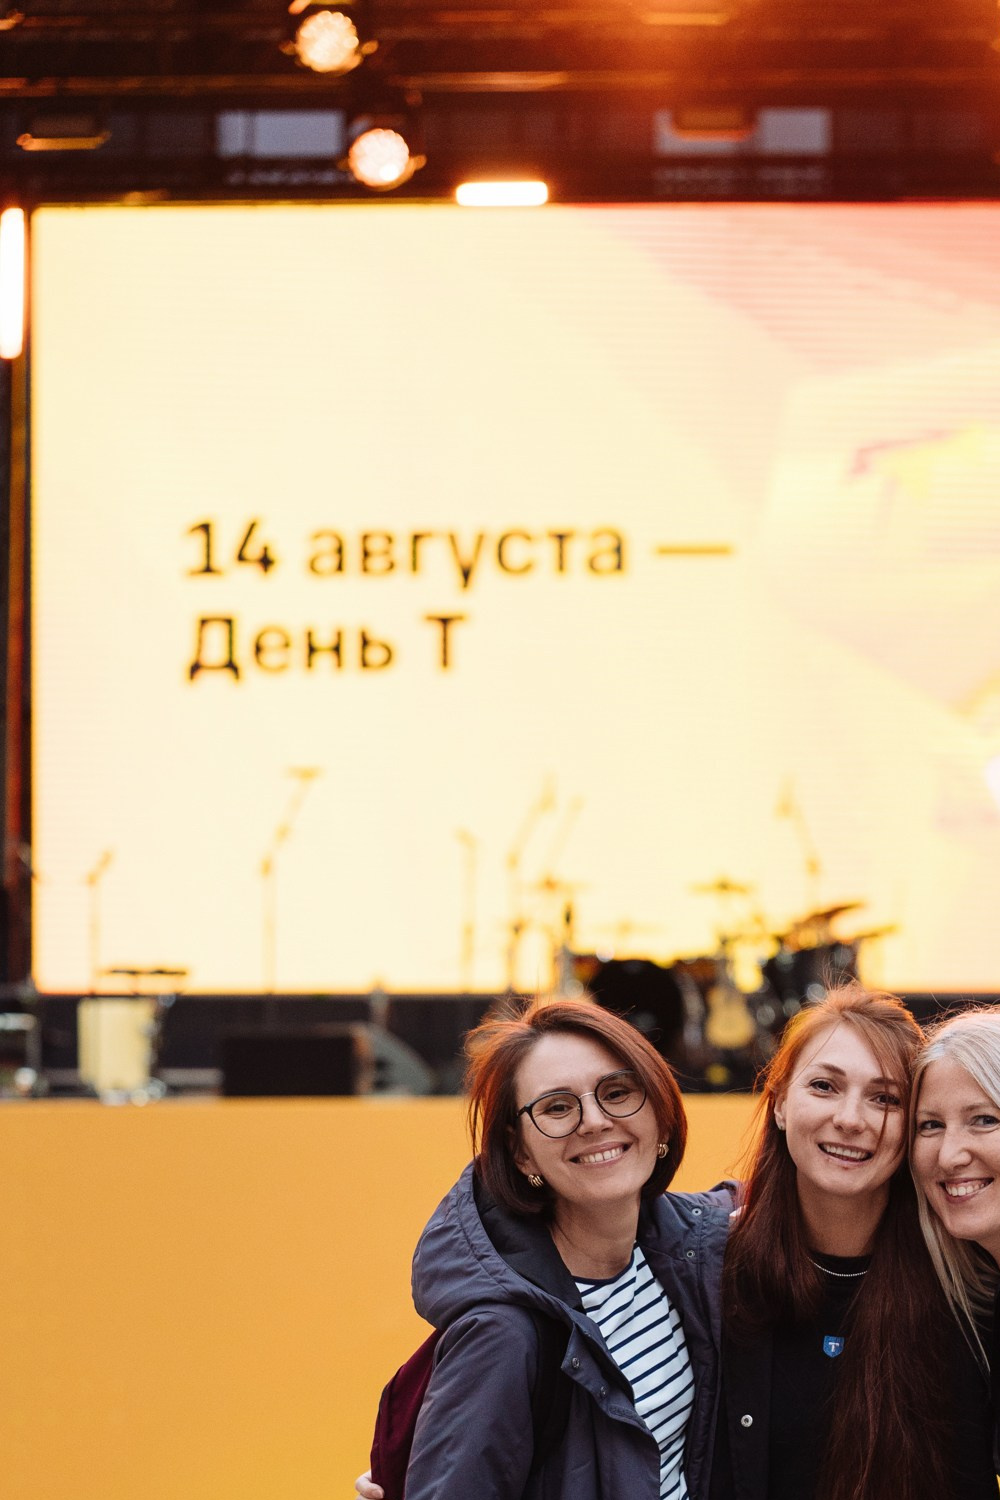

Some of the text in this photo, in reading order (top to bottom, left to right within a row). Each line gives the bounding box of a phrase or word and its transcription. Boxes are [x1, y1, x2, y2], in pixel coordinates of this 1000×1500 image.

[187, 518, 278, 577] 14
[307, 528, 627, 593] августа
[185, 613, 396, 684] День
